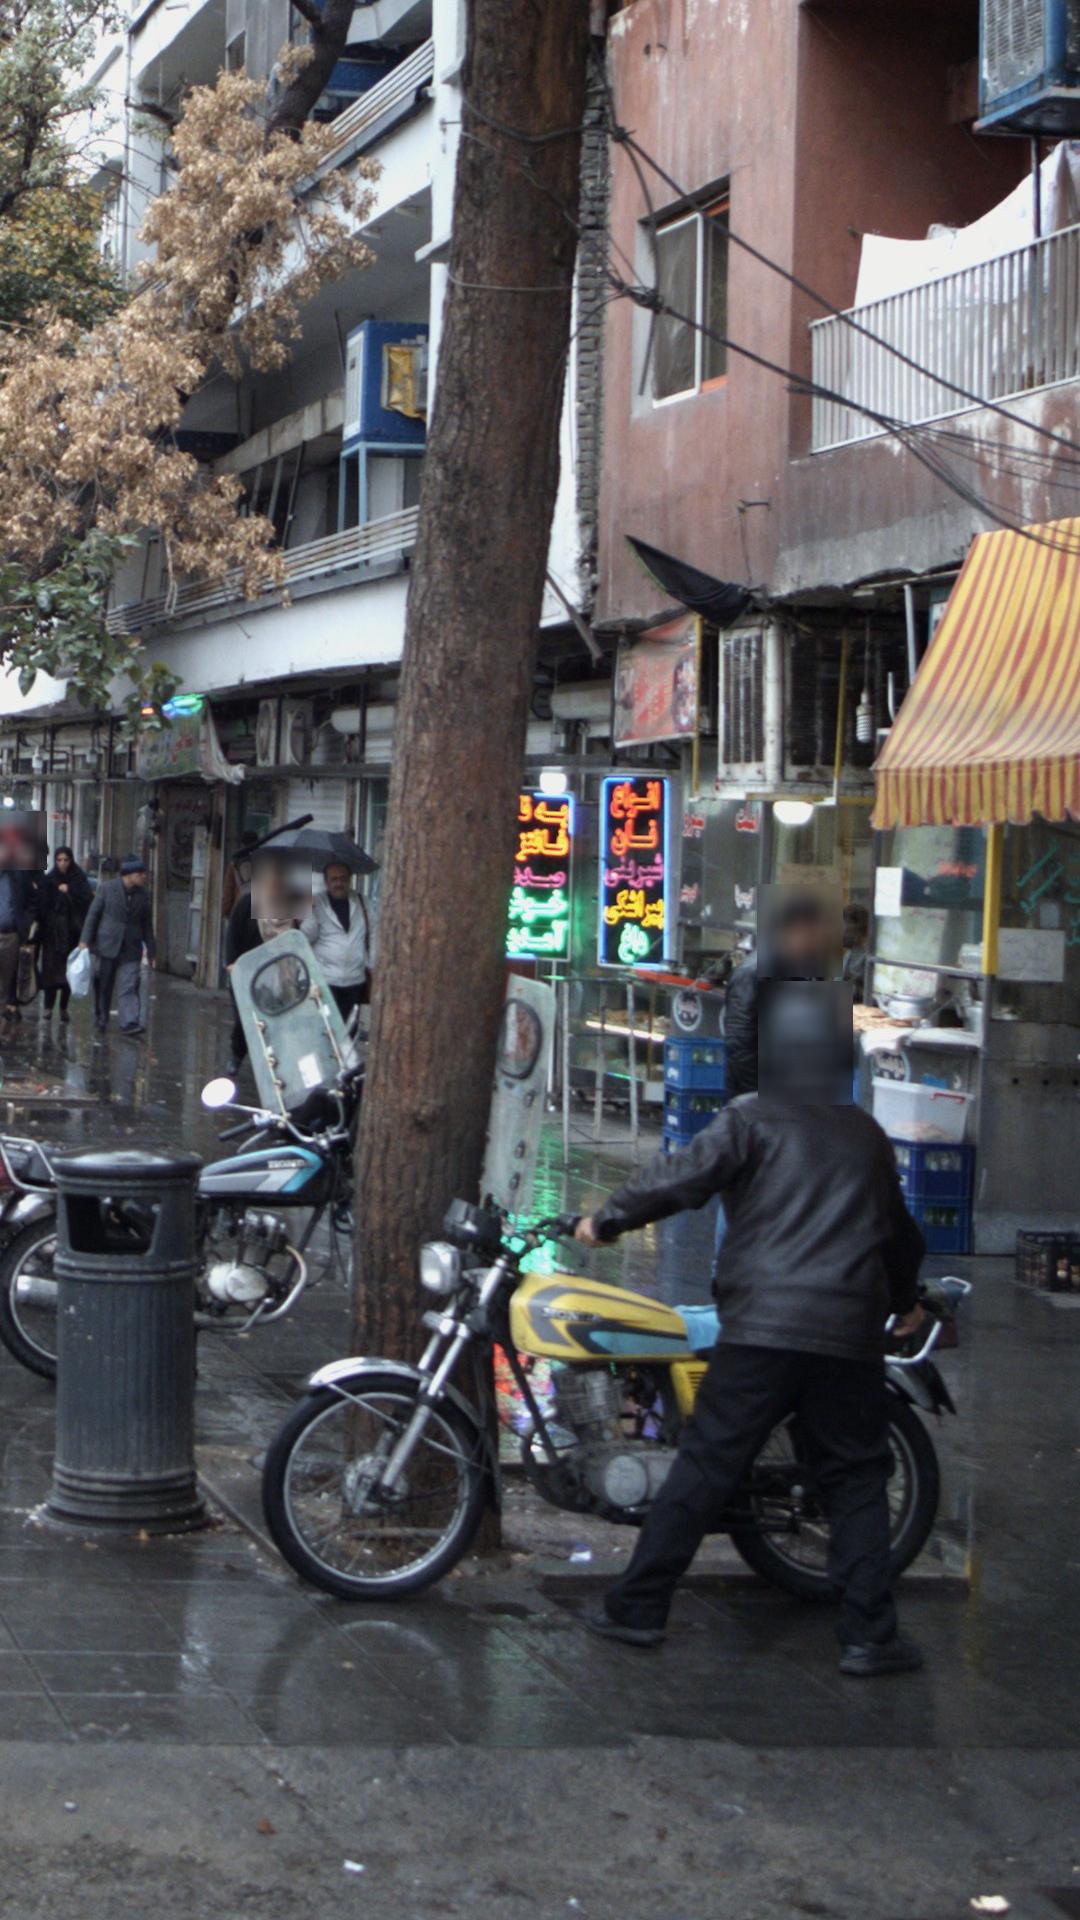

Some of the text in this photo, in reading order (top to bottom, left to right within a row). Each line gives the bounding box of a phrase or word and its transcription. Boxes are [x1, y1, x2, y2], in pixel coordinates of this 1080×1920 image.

[610, 781, 661, 818] انواع
[610, 818, 658, 856] نان
[618, 922, 650, 963] داغ
